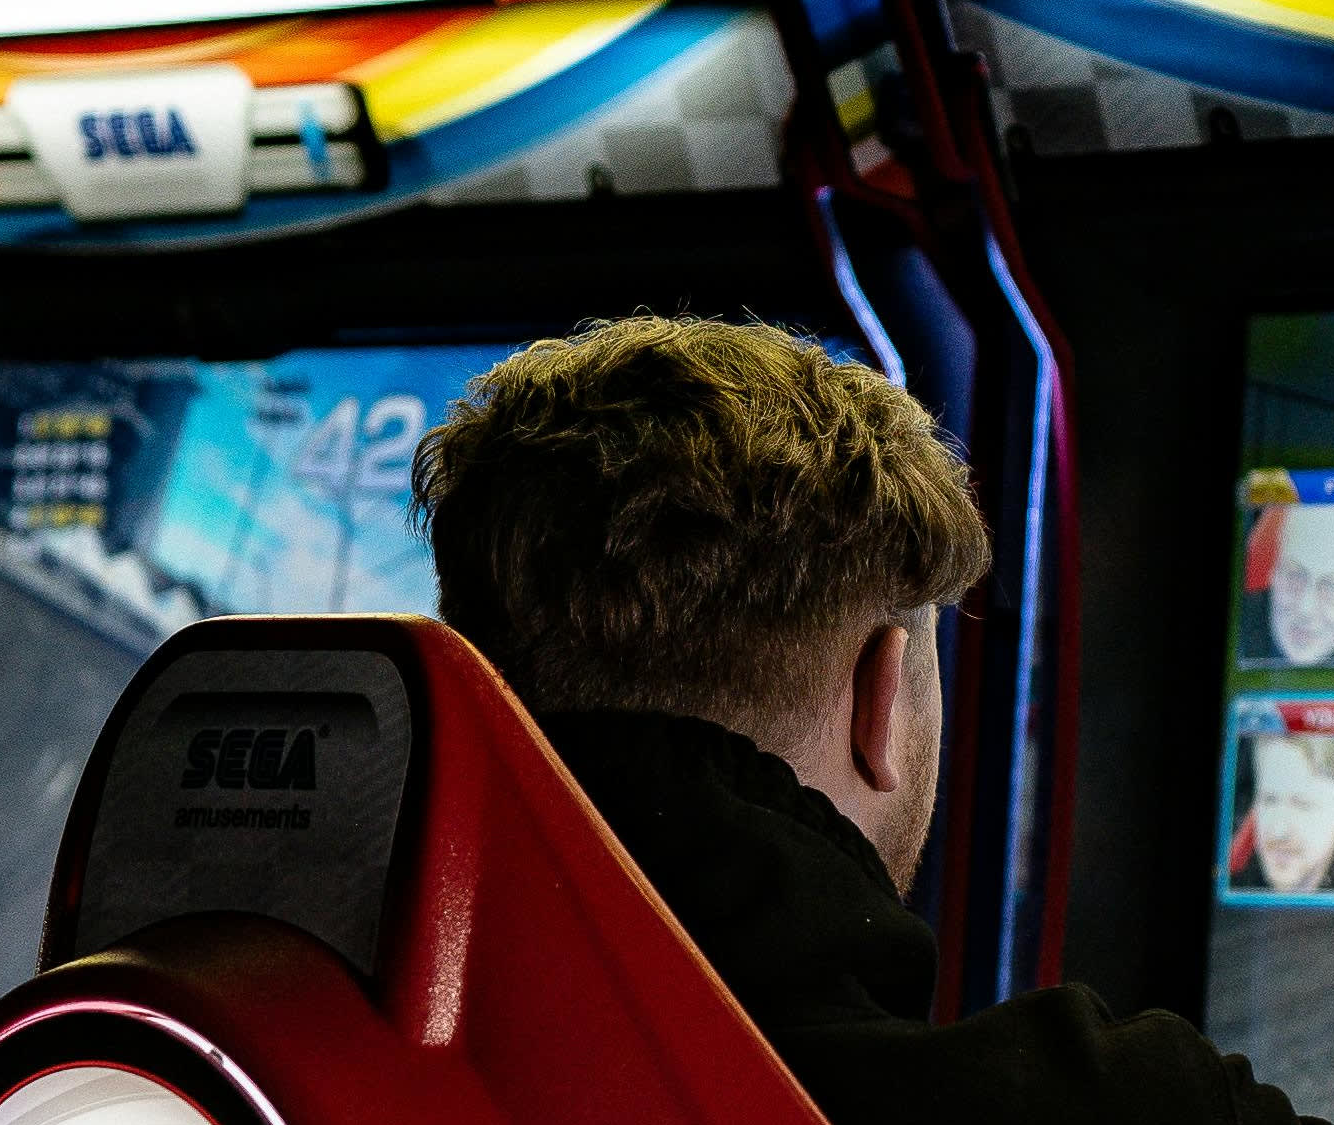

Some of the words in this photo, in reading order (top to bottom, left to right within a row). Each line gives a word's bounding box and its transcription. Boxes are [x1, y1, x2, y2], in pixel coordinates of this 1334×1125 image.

[80, 108, 199, 158] SEGA
[295, 394, 426, 489] 42
[181, 728, 317, 790] SEGA
[174, 804, 311, 829] amusements
